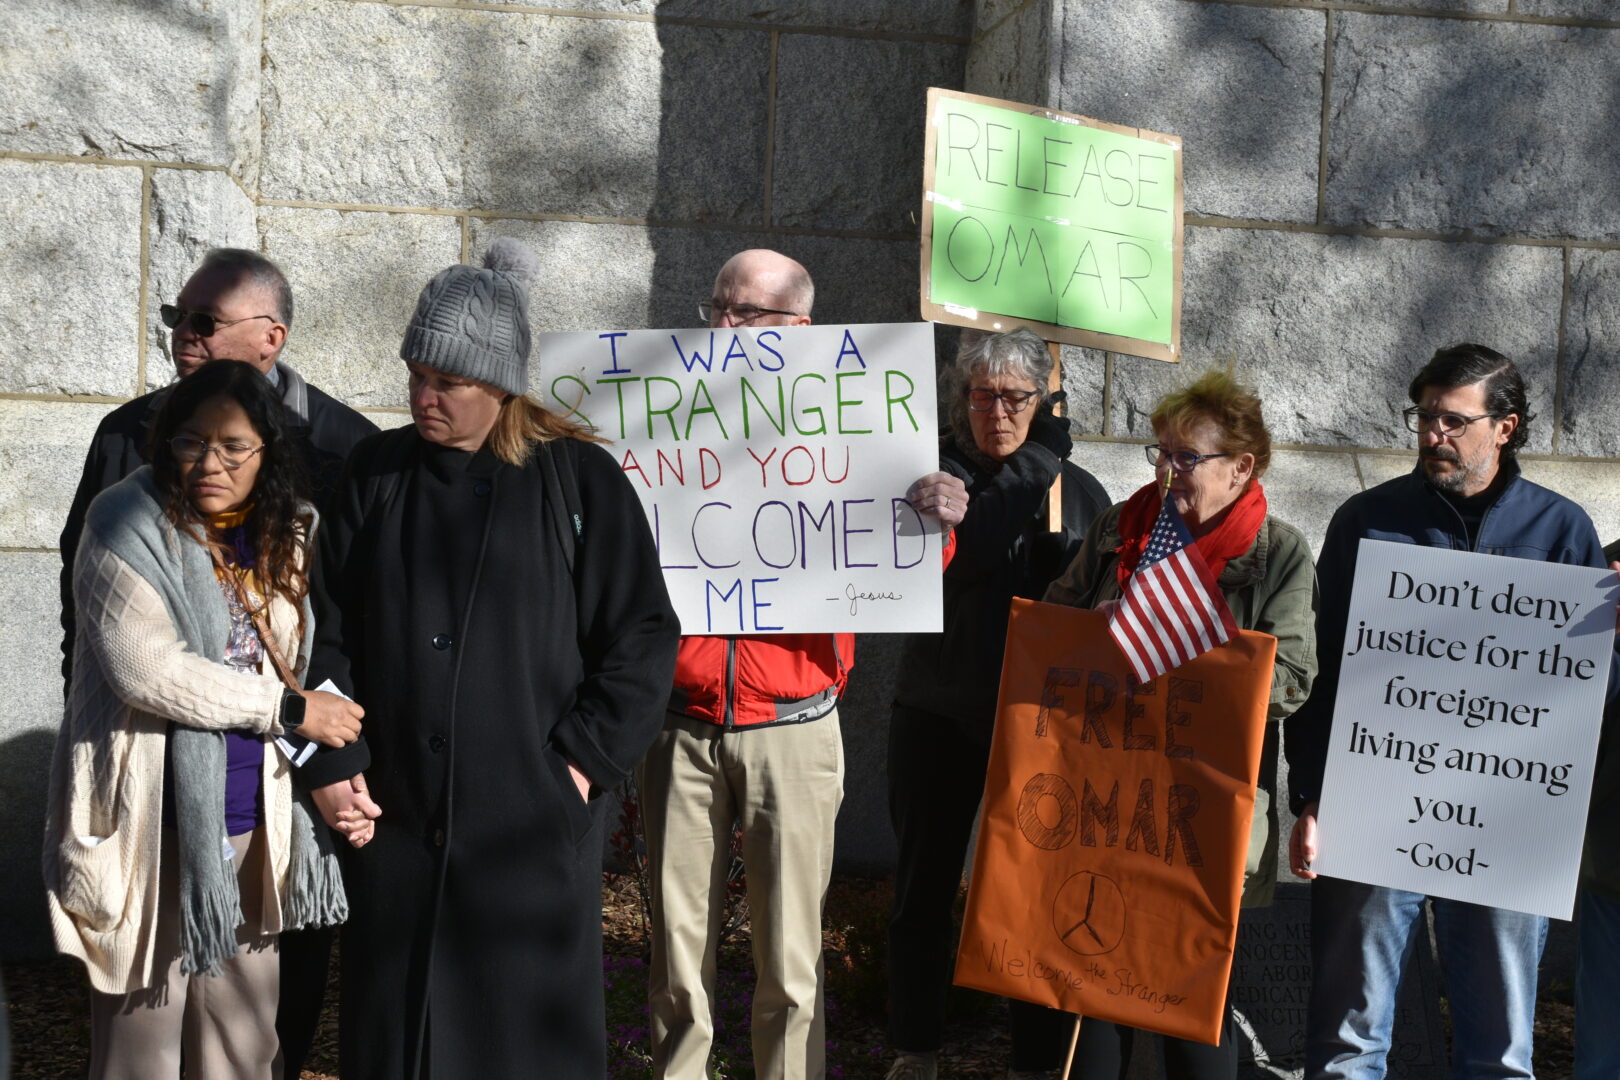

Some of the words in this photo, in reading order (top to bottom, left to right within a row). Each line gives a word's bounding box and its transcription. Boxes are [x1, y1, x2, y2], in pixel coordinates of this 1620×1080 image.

[946, 112, 1168, 213] RELEASE
[946, 216, 1158, 320] OMAR
[599, 332, 631, 375] I
[671, 330, 786, 373] WAS
[835, 329, 867, 369] A
[551, 370, 919, 441] STRANGER
[621, 447, 722, 490] AND
[747, 445, 850, 488] YOU
[653, 497, 927, 572] LCOMED
[705, 577, 785, 633] ME
[1387, 571, 1484, 611] Don't
[1491, 583, 1580, 629] deny
[1347, 620, 1467, 662] justice
[1474, 635, 1529, 670] for
[1537, 644, 1596, 680] the
[1035, 666, 1204, 761] FREE
[1383, 675, 1550, 728] foreigner
[1348, 722, 1440, 774] living
[1444, 748, 1574, 797] among
[1017, 773, 1204, 868] OMAR
[1408, 796, 1484, 828] you.
[980, 939, 1083, 991] Welcome
[1084, 960, 1107, 984] the
[1106, 968, 1188, 1014] Stranger
